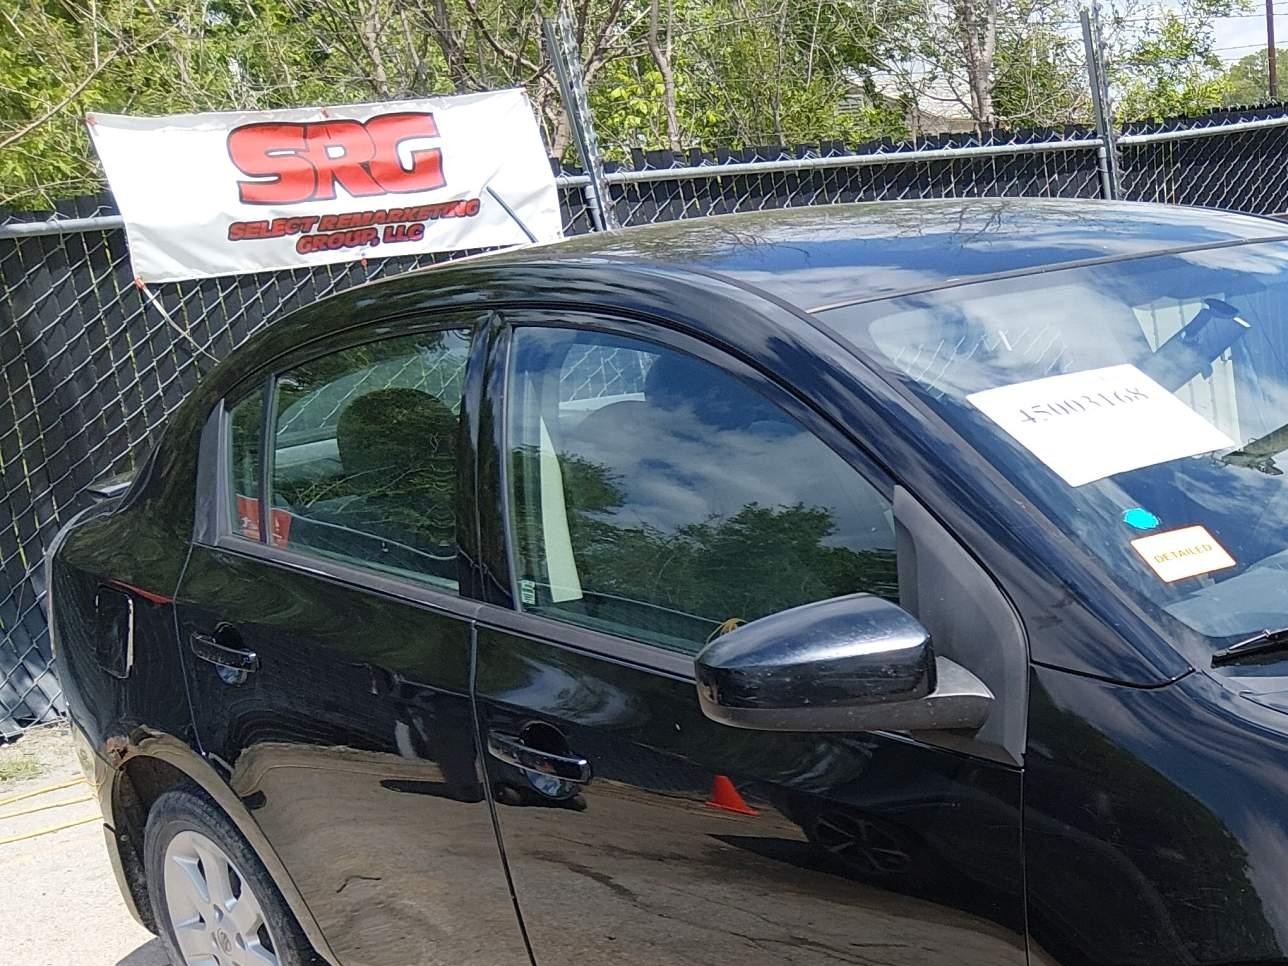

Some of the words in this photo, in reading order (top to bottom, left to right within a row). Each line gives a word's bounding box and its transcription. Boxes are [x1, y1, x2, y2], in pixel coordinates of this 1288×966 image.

[227, 112, 447, 206] SRG
[228, 215, 320, 241] SELECT
[318, 198, 481, 232] REMARKETING
[296, 227, 379, 254] GROUP,
[382, 223, 425, 243] LLC
[1018, 387, 1150, 424] 45003168
[1153, 543, 1213, 565] DETAILED
